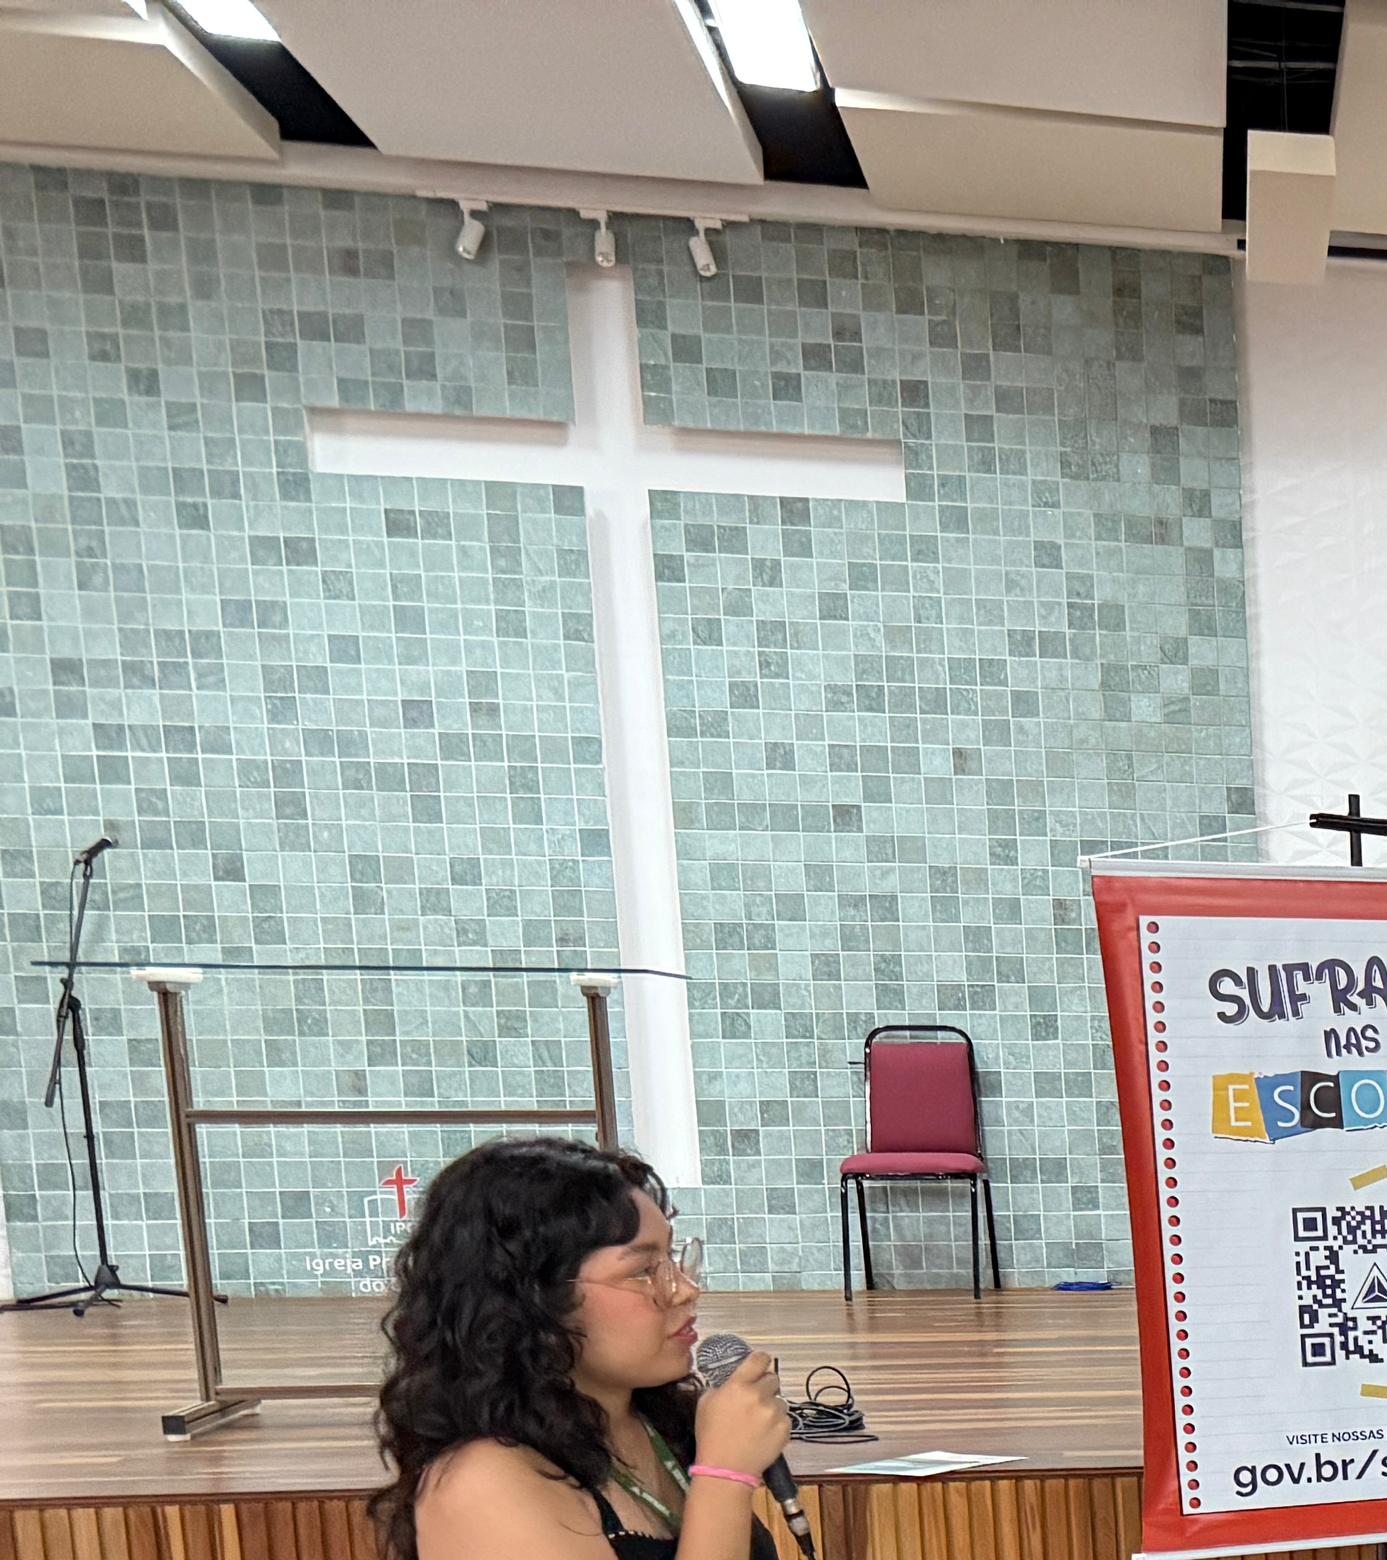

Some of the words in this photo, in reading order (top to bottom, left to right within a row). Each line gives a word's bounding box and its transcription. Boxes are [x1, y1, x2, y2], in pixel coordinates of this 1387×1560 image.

[305, 1254, 363, 1275] Igreja
[1286, 1433, 1329, 1446] VISITE
[1332, 1429, 1385, 1443] NOSSAS
